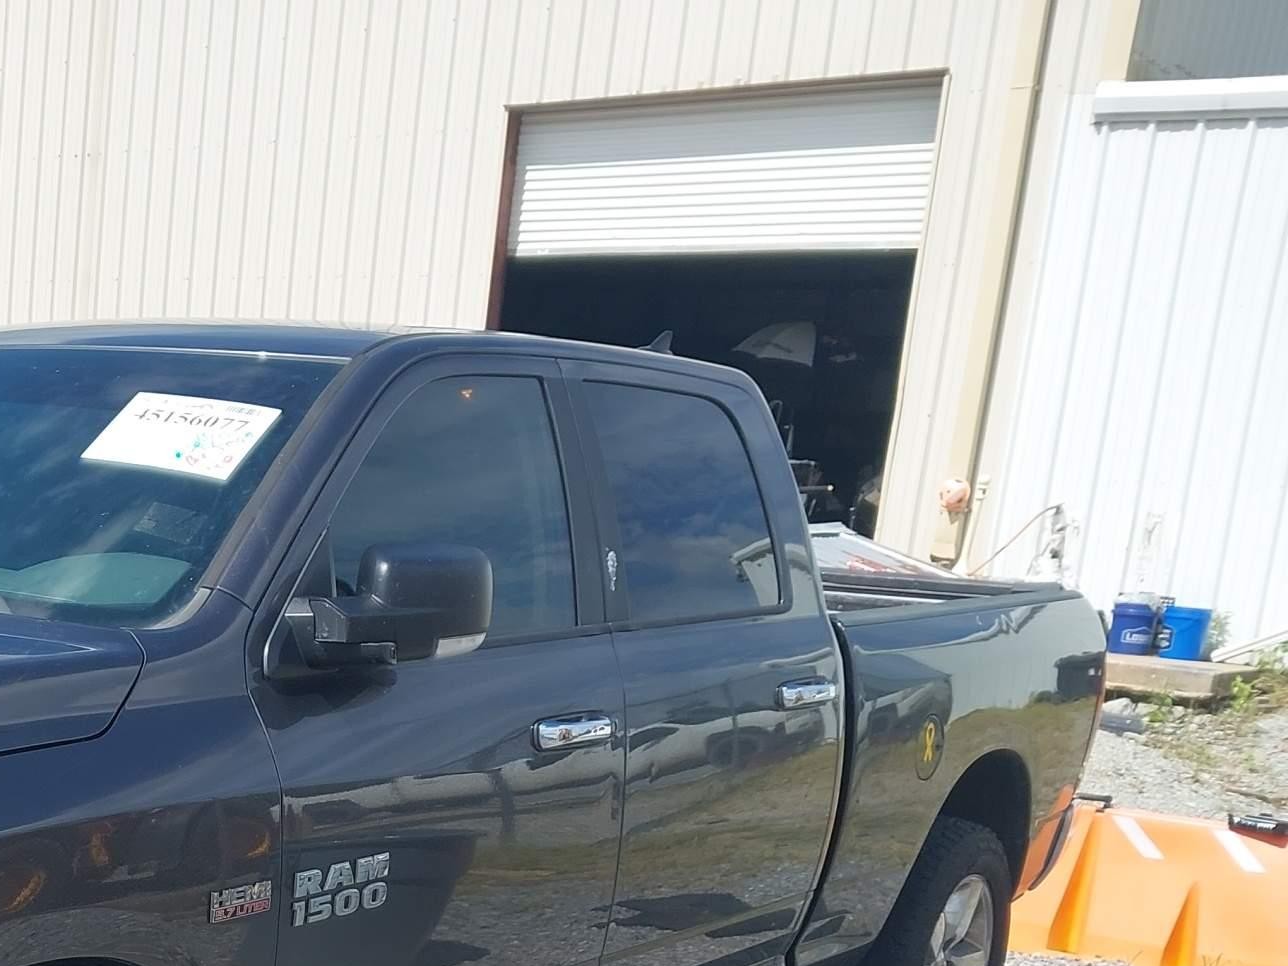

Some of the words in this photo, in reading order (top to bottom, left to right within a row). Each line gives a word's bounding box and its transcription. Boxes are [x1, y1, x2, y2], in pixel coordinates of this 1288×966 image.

[134, 408, 250, 431] 45156077
[294, 851, 390, 898] RAM
[211, 880, 272, 909] HEMI
[292, 881, 389, 927] 1500
[215, 907, 235, 921] 5.7
[236, 899, 269, 916] LITER
